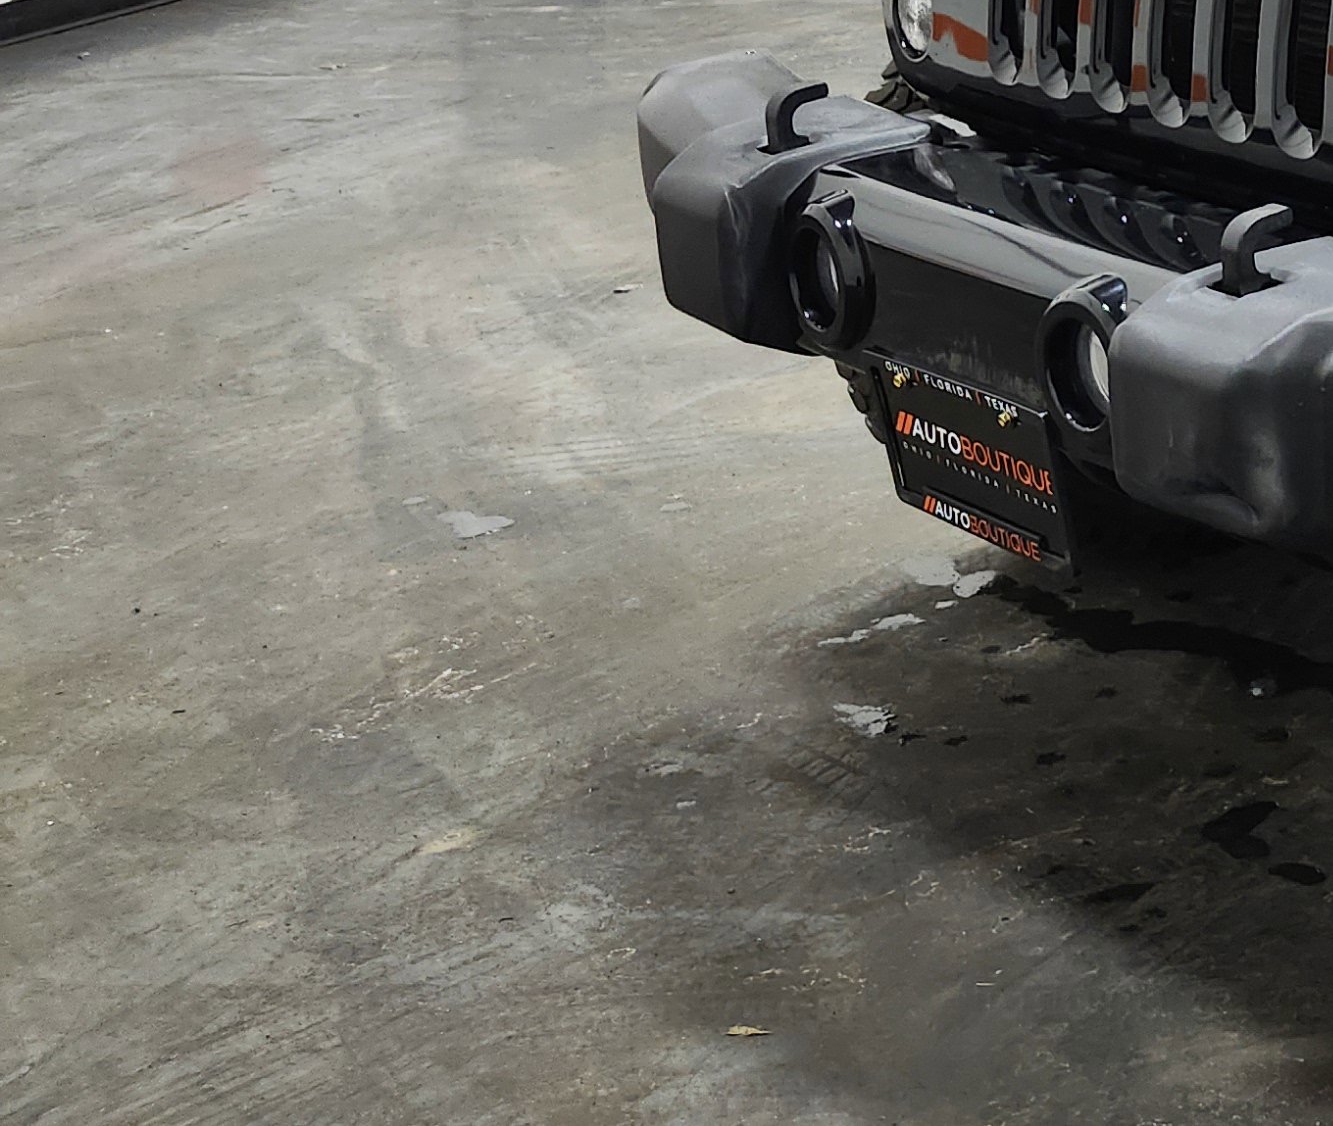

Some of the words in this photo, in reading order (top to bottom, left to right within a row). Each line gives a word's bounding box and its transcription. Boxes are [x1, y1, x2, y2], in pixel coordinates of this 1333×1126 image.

[885, 361, 911, 377] OHIO
[924, 374, 973, 401] FLORIDA
[984, 395, 1018, 418] TEXAS
[902, 441, 932, 459] OHIO
[945, 458, 999, 488] FLORIDA
[1016, 489, 1058, 514] TEXAS
